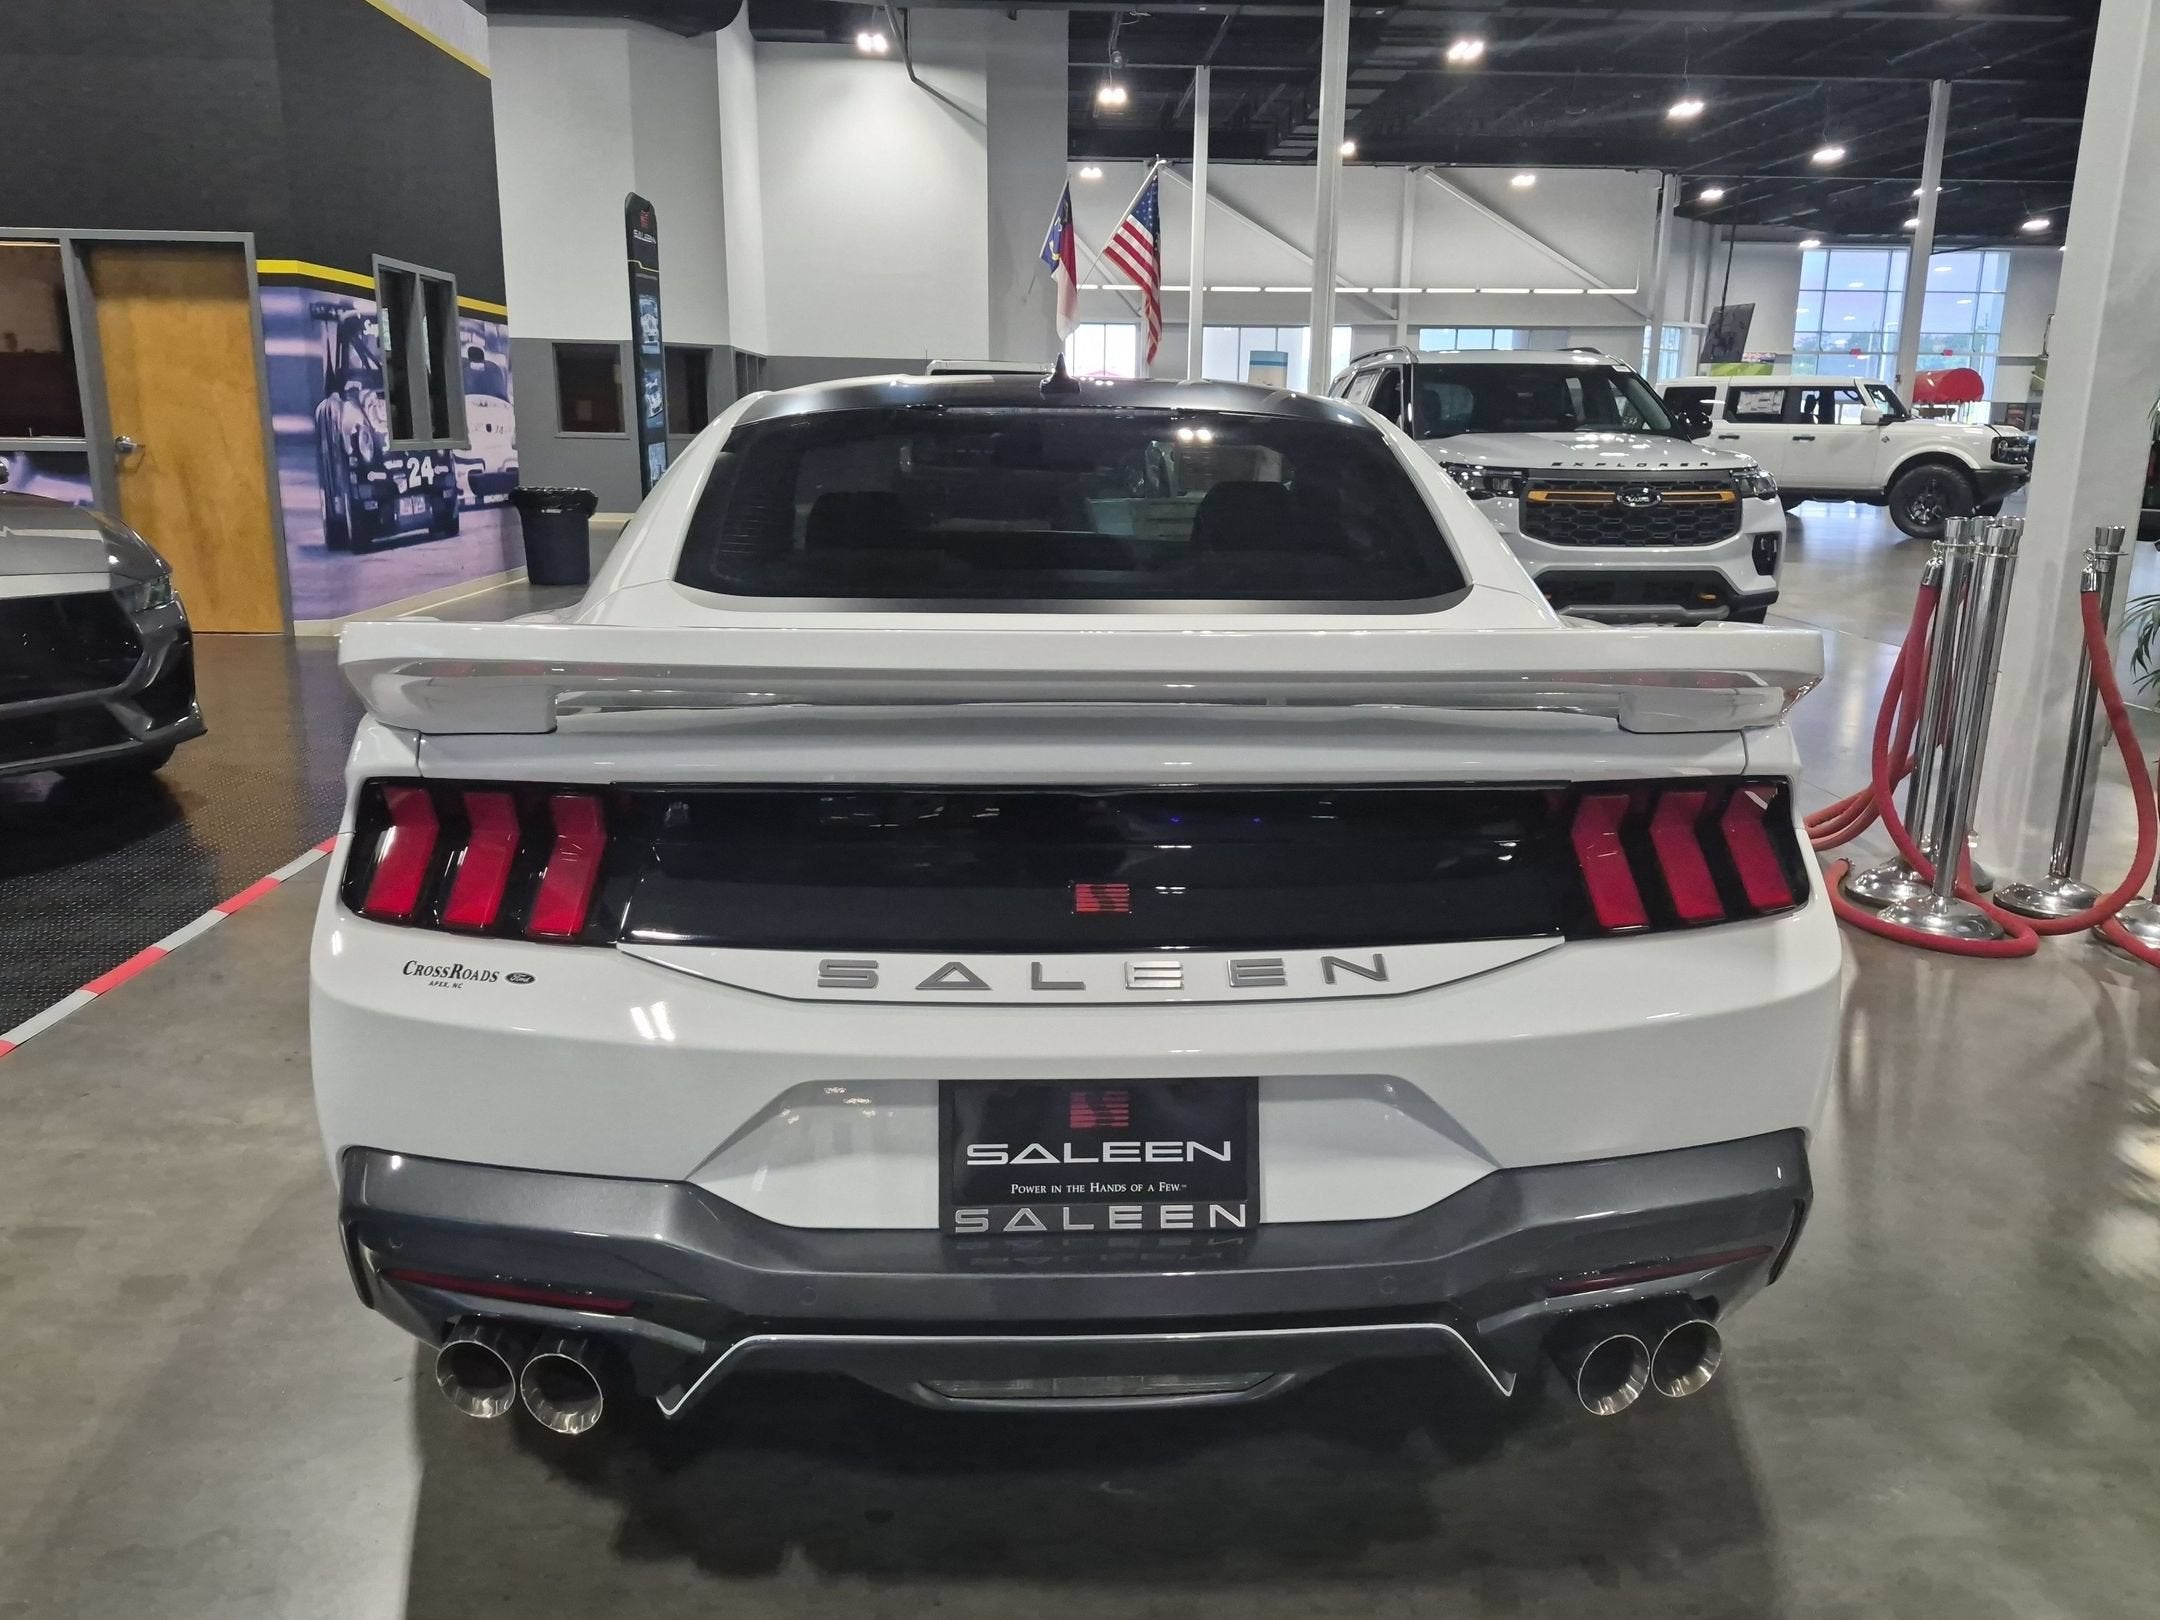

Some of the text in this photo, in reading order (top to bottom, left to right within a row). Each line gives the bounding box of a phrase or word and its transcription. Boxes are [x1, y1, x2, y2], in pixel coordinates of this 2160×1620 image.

[406, 455, 435, 489] 24
[817, 953, 1390, 991] SALEEN
[966, 1140, 1232, 1166] SALEEN
[955, 1203, 1247, 1233] SALEEN
